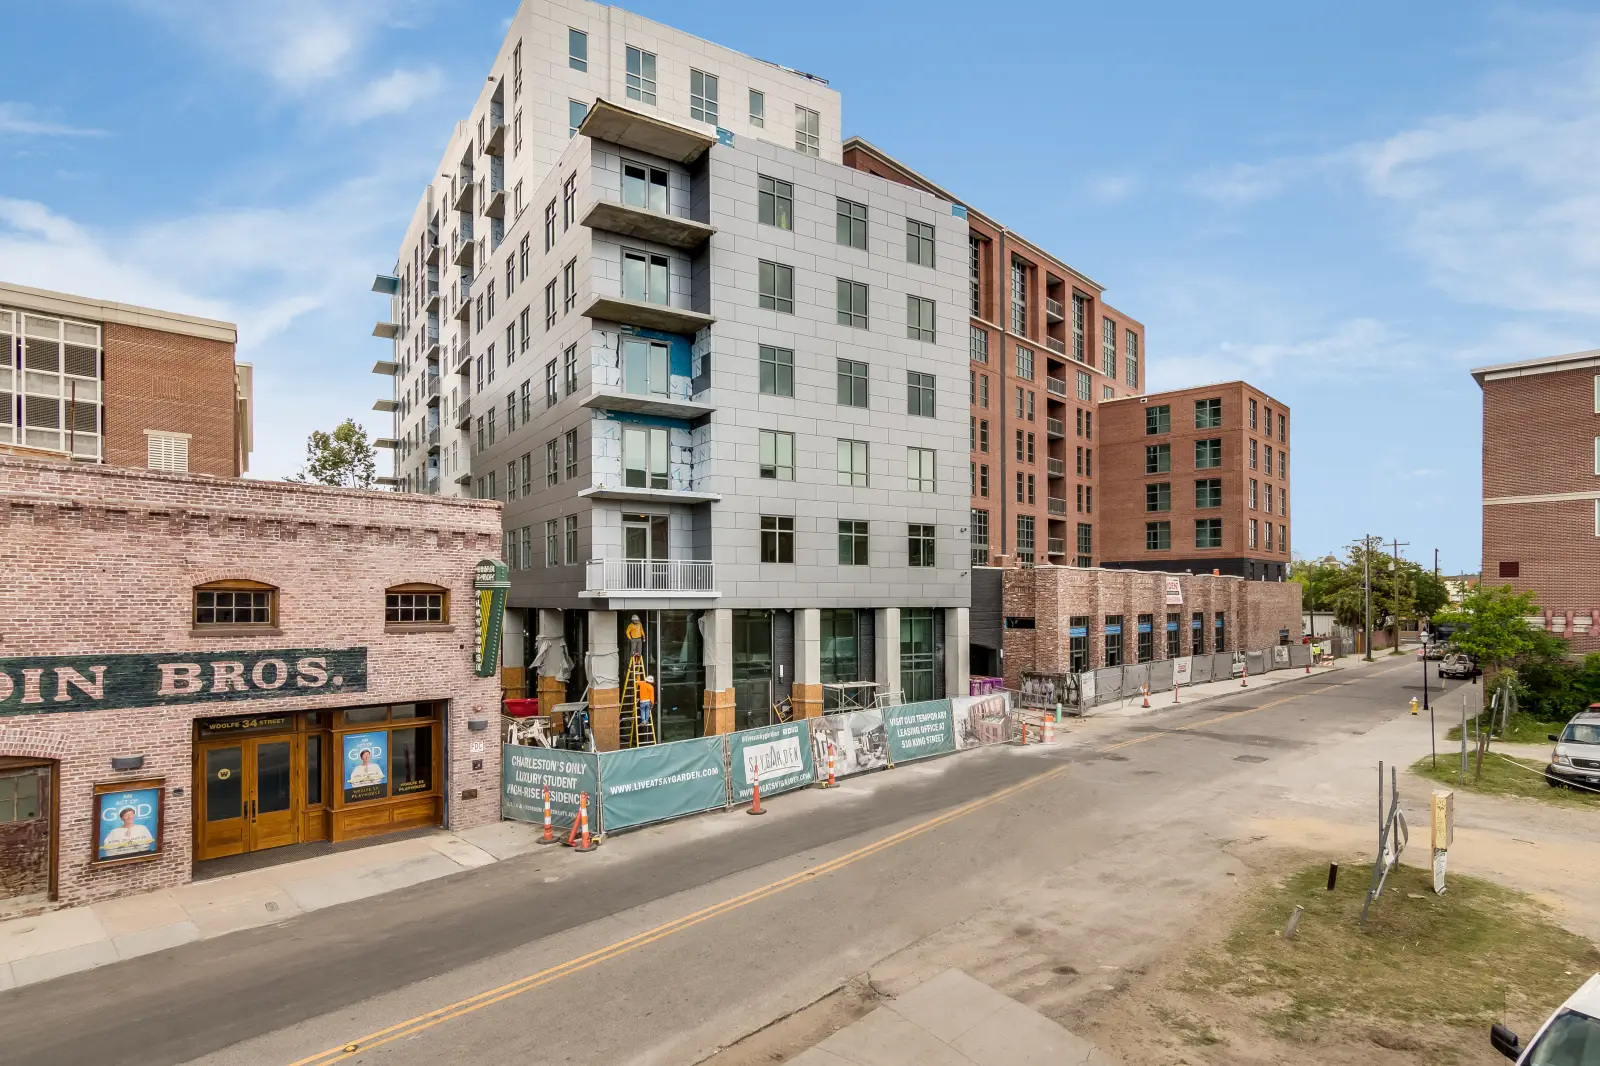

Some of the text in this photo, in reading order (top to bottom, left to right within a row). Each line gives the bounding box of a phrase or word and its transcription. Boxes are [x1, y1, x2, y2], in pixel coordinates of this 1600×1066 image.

[157, 656, 345, 696] BROS.
[209, 722, 240, 730] WOOLFE
[242, 719, 258, 728] 34
[889, 710, 946, 726] VISIT OUR TEMPORARY
[897, 722, 945, 737] LEASING OFFICE AT
[902, 734, 944, 748] 510 KING STREET
[512, 756, 587, 774] CHARLESTON'S ONLY
[516, 770, 577, 789] LUXURY STUDENT
[610, 766, 719, 795] WWW.LIVEATSKYGARDEN.COM
[506, 783, 540, 800] HIGH-RISE
